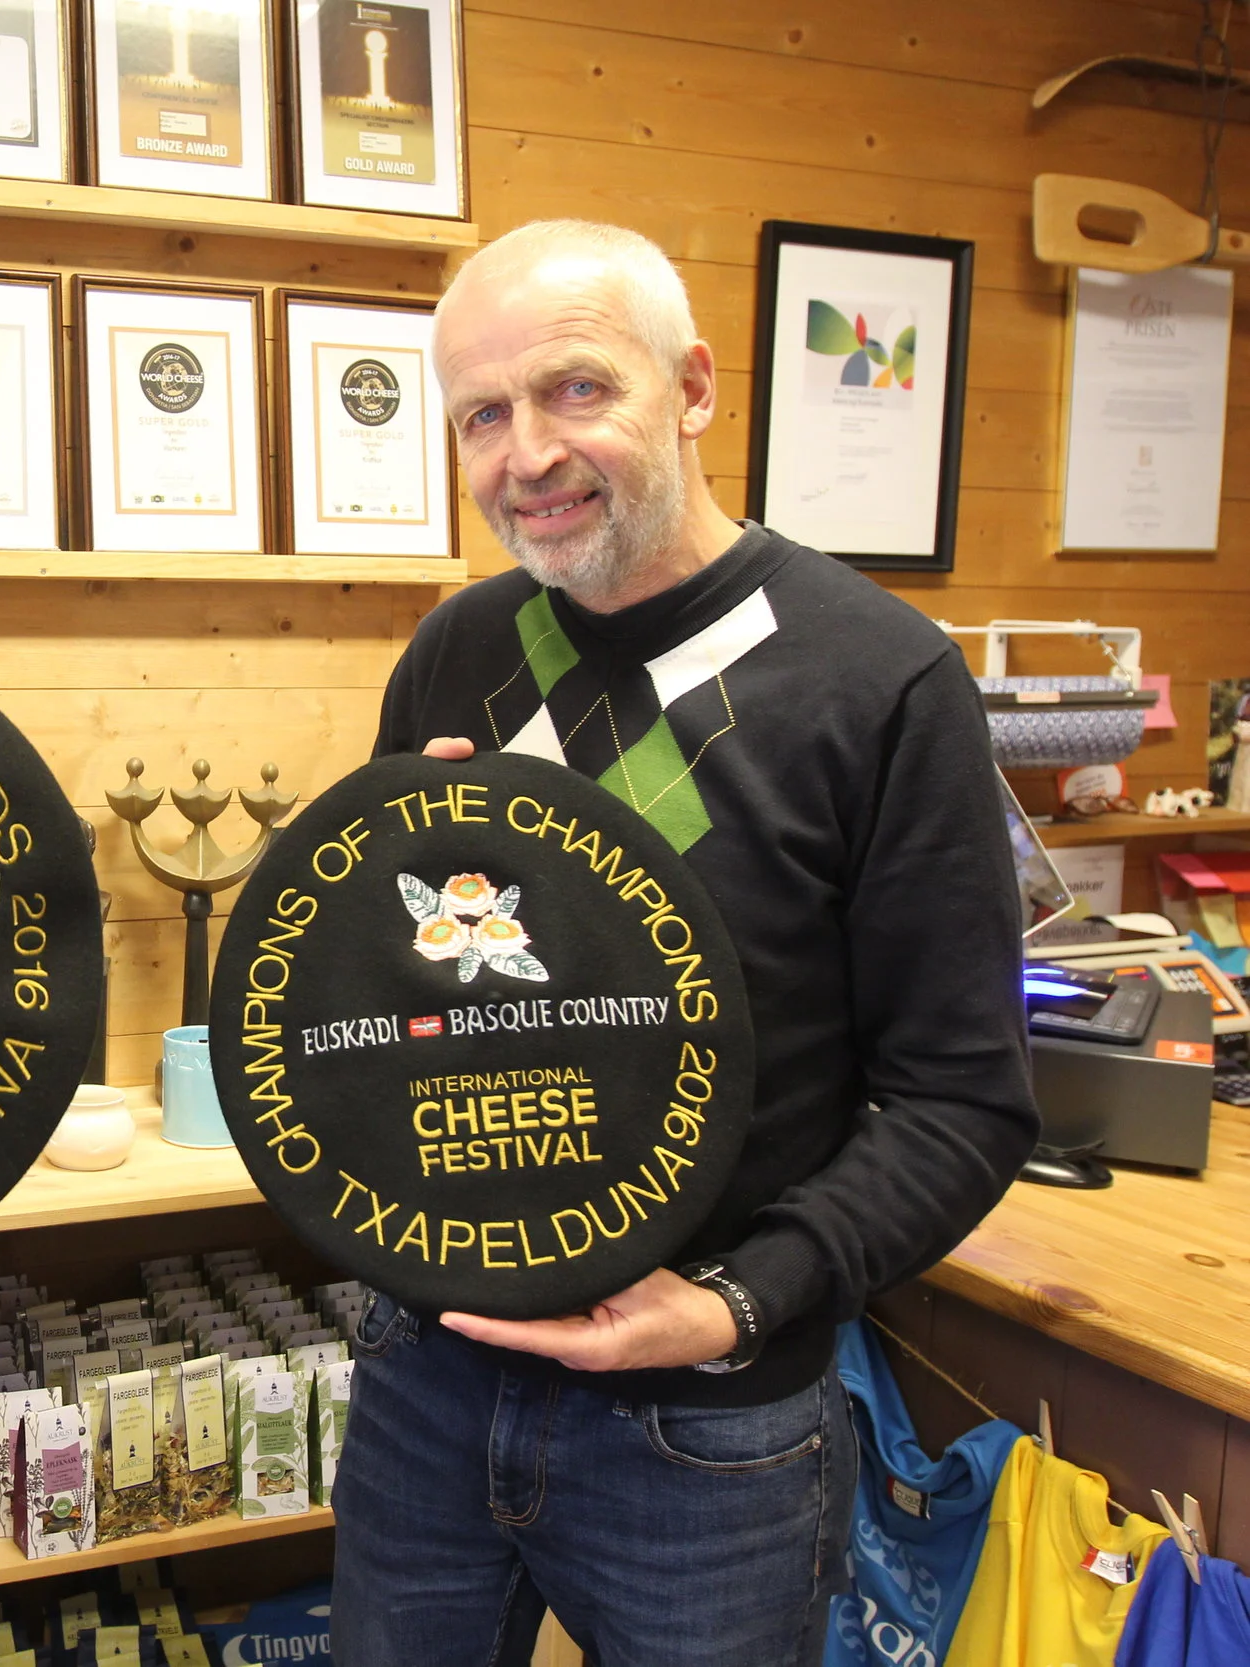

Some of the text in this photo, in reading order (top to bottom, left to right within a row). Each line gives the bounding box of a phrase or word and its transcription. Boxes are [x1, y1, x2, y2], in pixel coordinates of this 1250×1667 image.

[136, 136, 228, 158] BRONZE AWARD
[345, 156, 415, 175] GOLD AWARD
[1124, 320, 1177, 339] PRISEN
[140, 372, 204, 384] WORLD CHEESE
[157, 392, 188, 404] AWARDS
[341, 386, 399, 399] WORLD CHEESE
[356, 406, 385, 417] AWARDS
[138, 416, 209, 428] SUPER GOLD
[338, 429, 405, 441] SUPER GOLD
[12, 892, 50, 1012] 2016
[241, 783, 719, 1176] CHAMPIONS OF THE CHAMPIONS 2016
[301, 995, 670, 1057] EUSKADI BASQUE COUNTRY
[409, 1066, 593, 1099] INTERNATIONAL
[412, 1086, 599, 1140] CHEESE
[417, 1131, 604, 1178] FESTIVAL
[331, 1143, 696, 1270] TXAPELDUNA
[42, 1326, 79, 1338] FARGEGLEDE
[111, 1331, 149, 1345] FARGEGLEDE
[146, 1354, 182, 1369] FARGEGLEDE
[79, 1364, 117, 1379] FARGEGLEDE
[185, 1366, 219, 1382] FARGEGLEDE
[113, 1386, 150, 1401] FARGEGLEDE
[262, 1393, 288, 1403] AUKRUST
[47, 1429, 73, 1440] AUKRUST
[46, 1456, 78, 1469] EPLEKNASK
